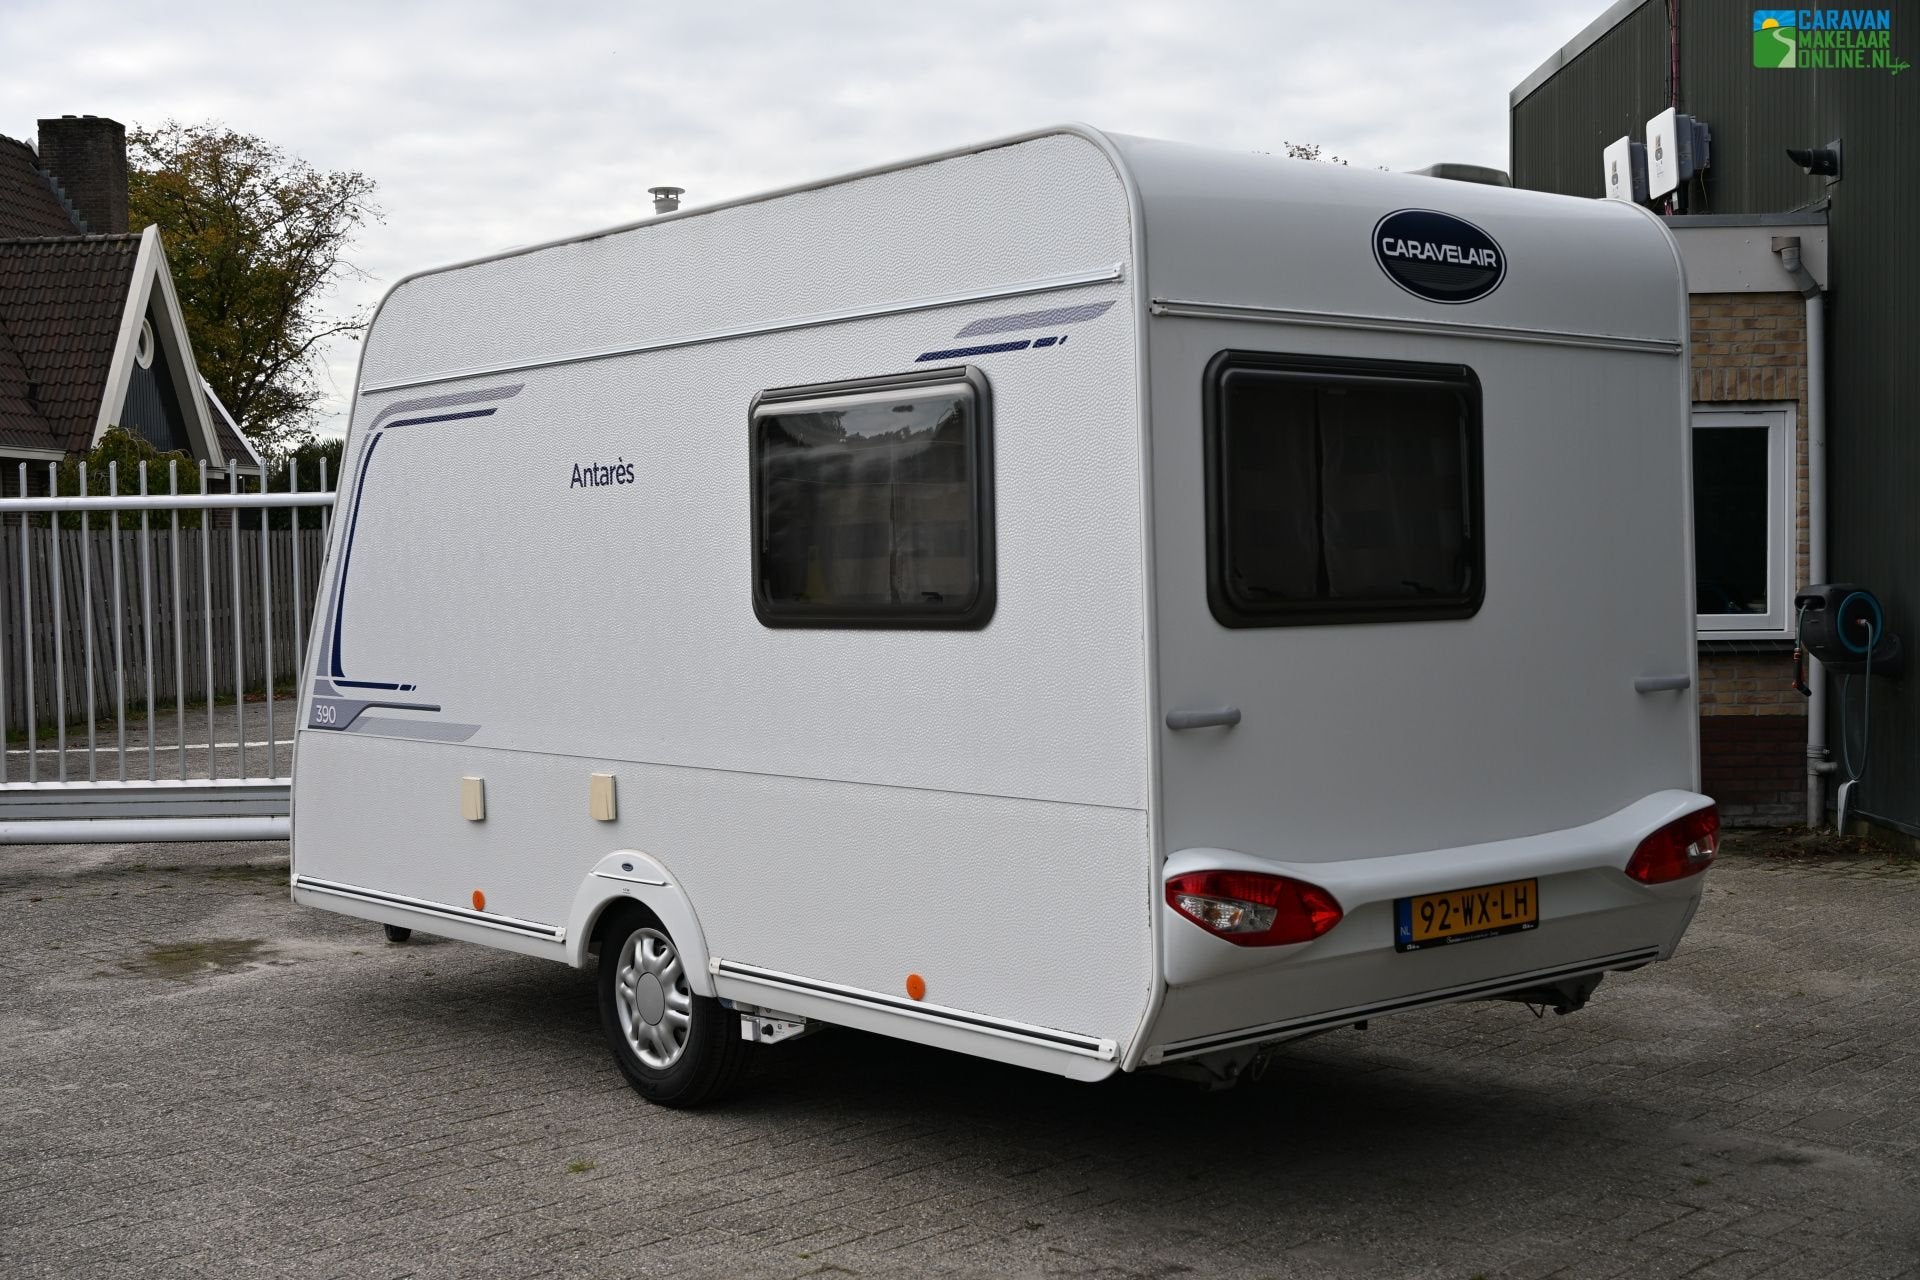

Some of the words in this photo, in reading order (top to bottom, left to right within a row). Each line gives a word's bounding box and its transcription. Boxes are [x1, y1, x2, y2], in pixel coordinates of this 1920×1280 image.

[1382, 237, 1497, 268] CARAVELAIR
[570, 456, 635, 489] Antarès
[315, 705, 336, 724] 390
[1420, 885, 1528, 934] 92-WX-LH
[1400, 926, 1411, 937] NL
